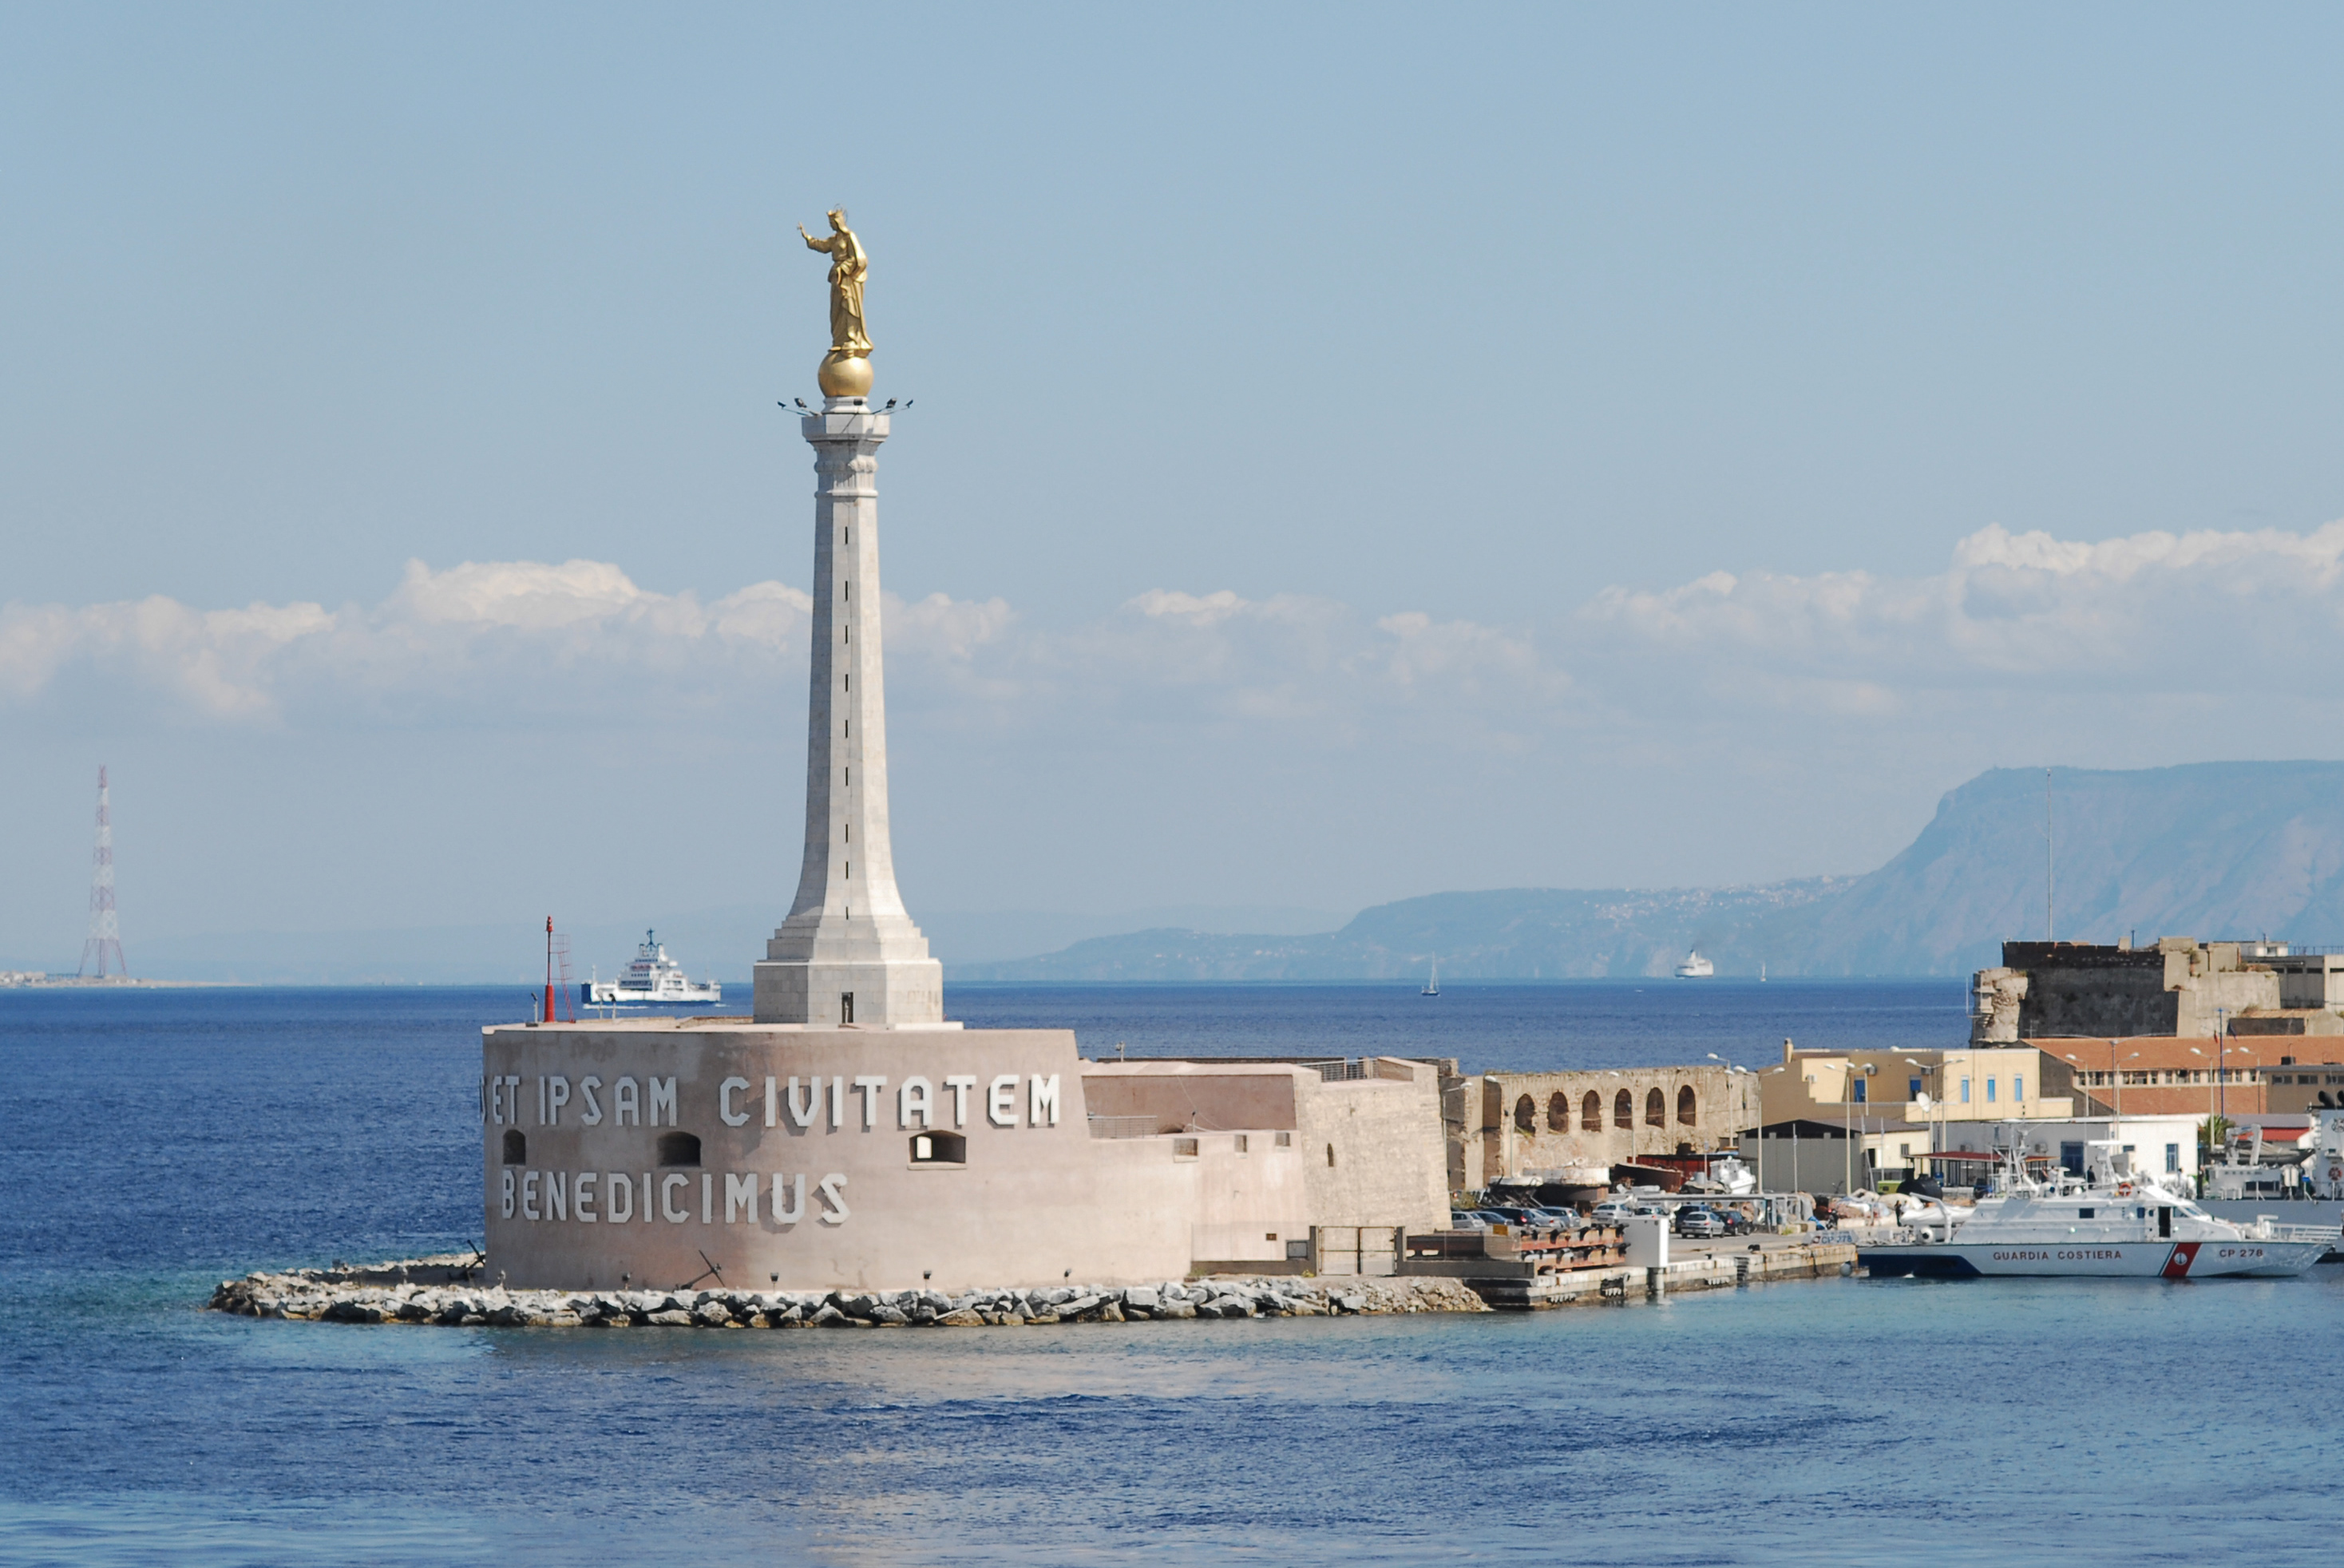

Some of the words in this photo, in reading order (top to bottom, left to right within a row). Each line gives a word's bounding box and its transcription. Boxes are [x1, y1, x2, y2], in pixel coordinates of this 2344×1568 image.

[493, 1075, 520, 1124] ET
[539, 1076, 677, 1127] IPSAM
[720, 1074, 1059, 1127] CIVITATEM
[502, 1170, 850, 1223] BENEDICIMUS
[1993, 1251, 2049, 1261] GUARDIA
[2057, 1250, 2122, 1260] COSTIERA
[2219, 1249, 2235, 1257] CP
[2239, 1249, 2263, 1257] 278
